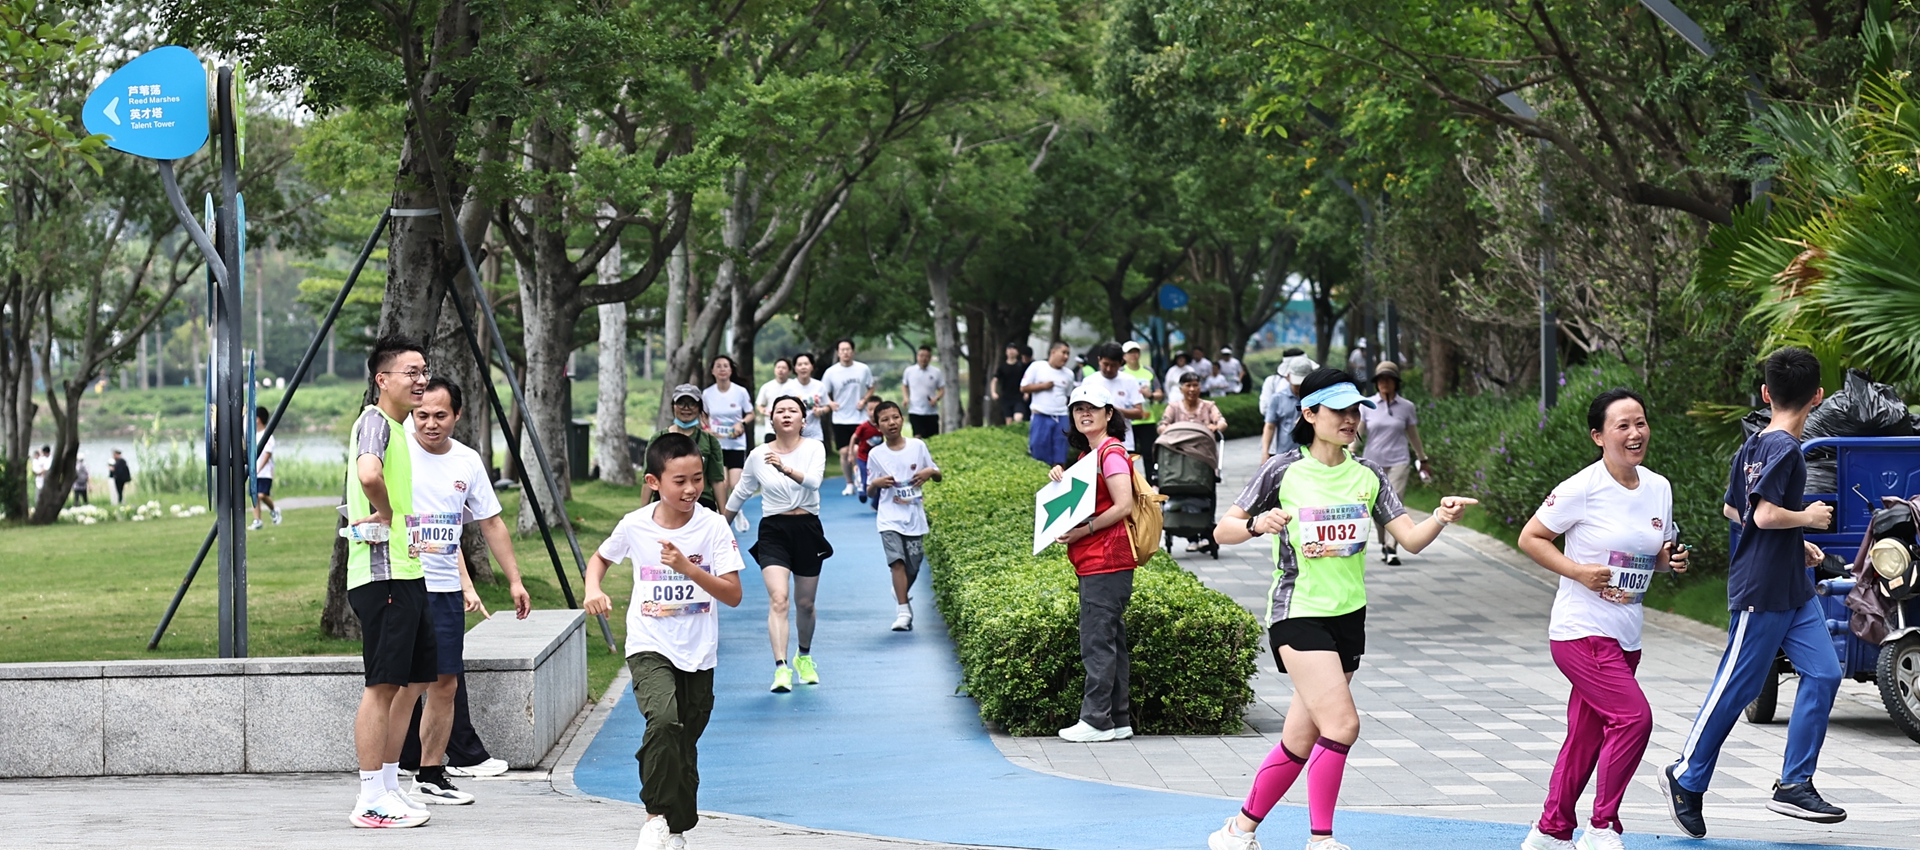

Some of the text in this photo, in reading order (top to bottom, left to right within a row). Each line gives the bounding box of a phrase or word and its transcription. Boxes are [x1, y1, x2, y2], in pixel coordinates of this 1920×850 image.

[128, 84, 161, 97] 芦苇荡
[149, 96, 180, 104] Marshes
[130, 106, 163, 120] 英才塔
[154, 120, 175, 128] Tower
[421, 527, 454, 541] M026
[1316, 523, 1357, 542] V032
[1618, 572, 1649, 590] M032
[653, 585, 695, 602] C032
